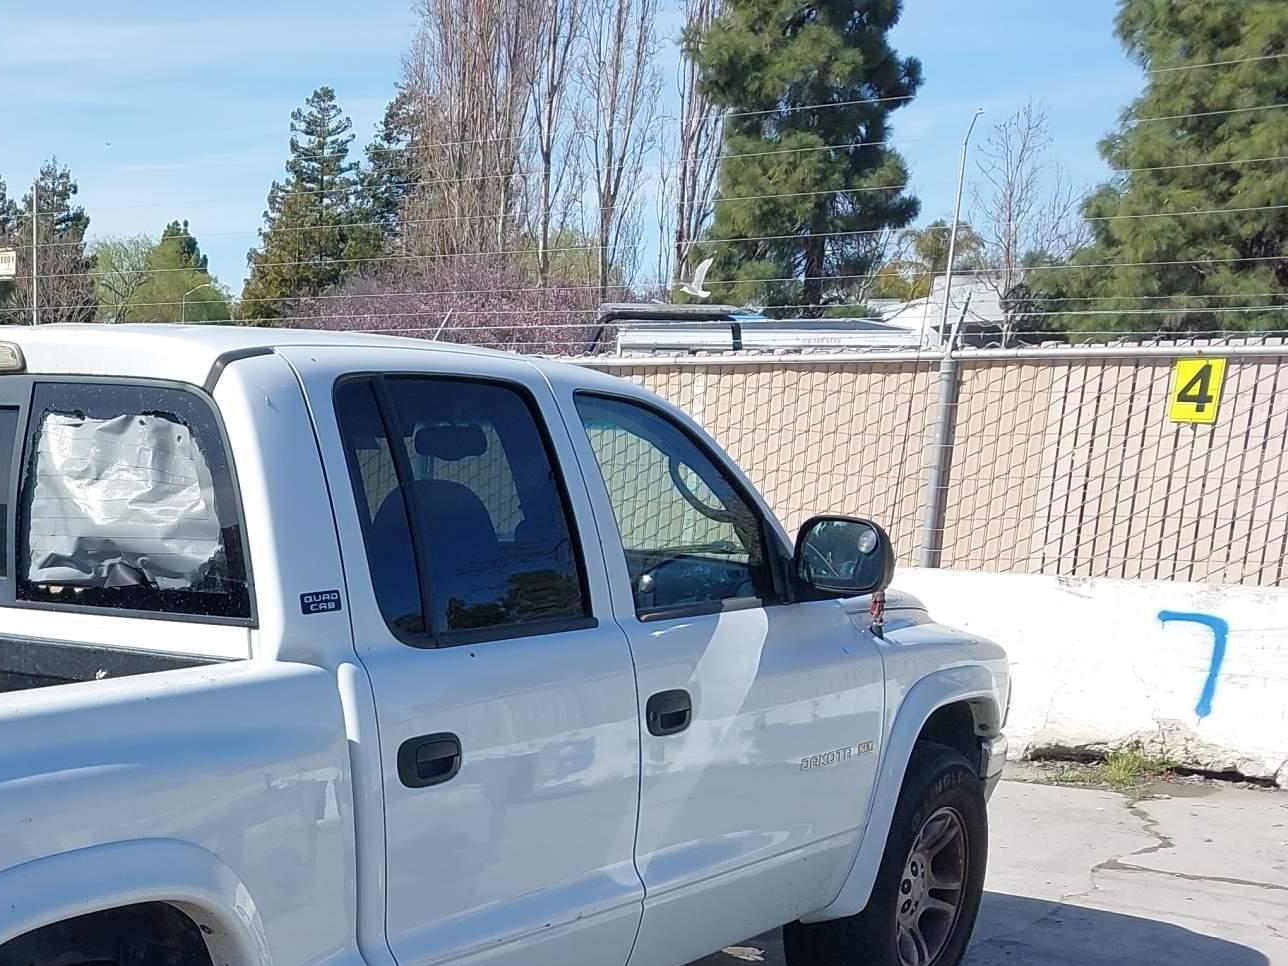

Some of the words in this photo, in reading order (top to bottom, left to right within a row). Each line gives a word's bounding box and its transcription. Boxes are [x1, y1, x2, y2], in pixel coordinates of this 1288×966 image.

[1176, 363, 1214, 413] 4
[303, 592, 338, 604] QUAD
[309, 601, 336, 611] CAB
[1157, 609, 1229, 718] 7
[799, 746, 853, 772] DAKOTA
